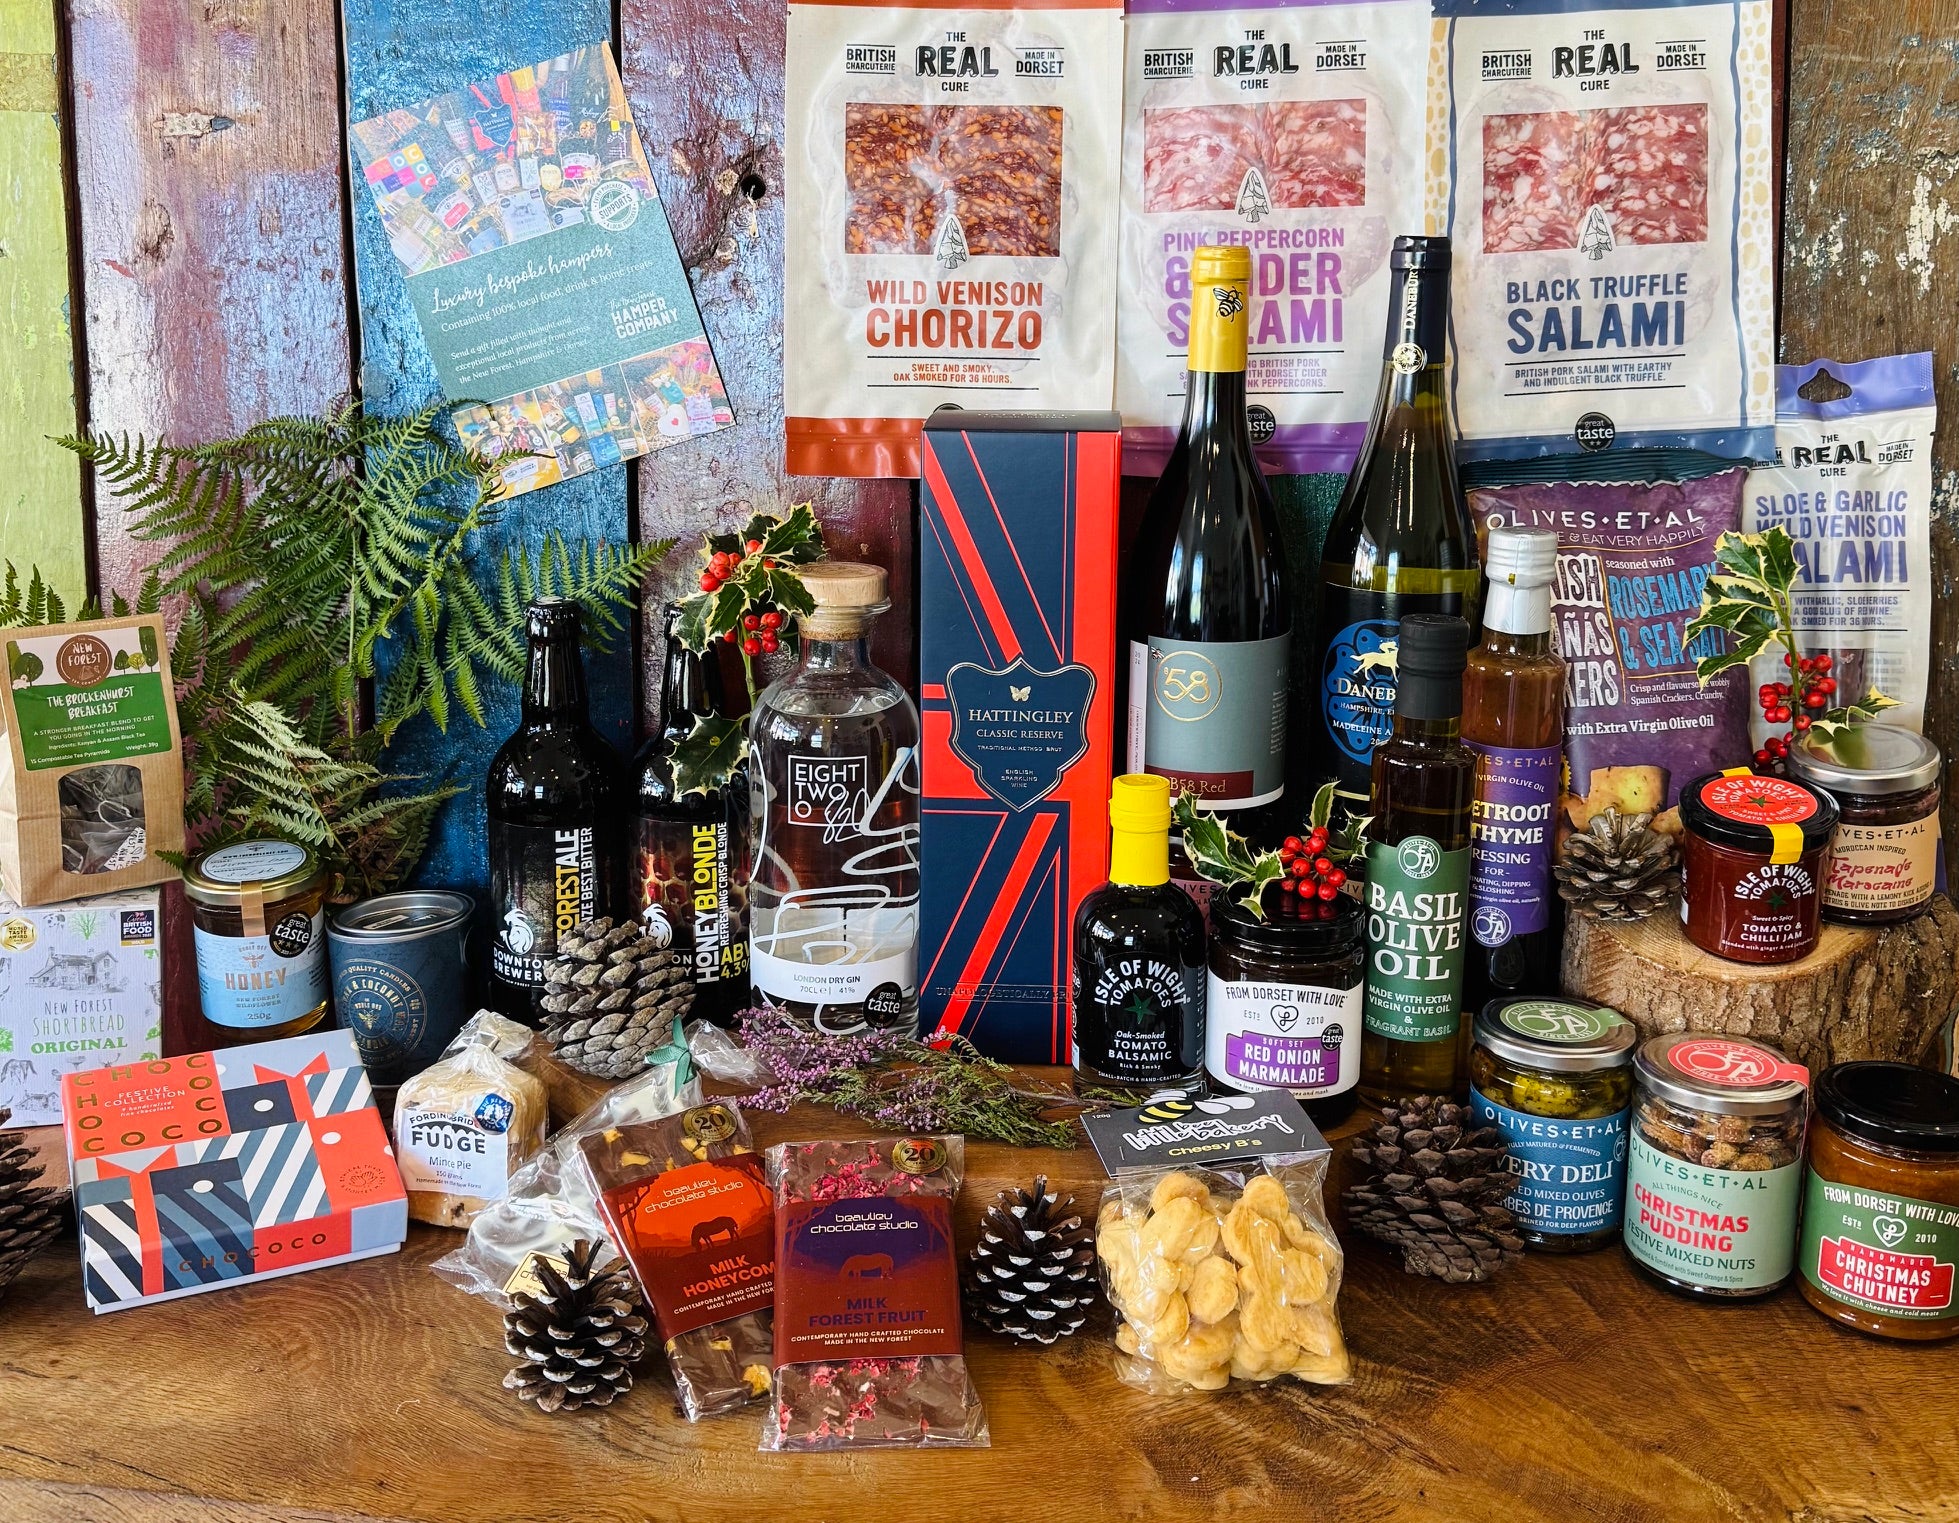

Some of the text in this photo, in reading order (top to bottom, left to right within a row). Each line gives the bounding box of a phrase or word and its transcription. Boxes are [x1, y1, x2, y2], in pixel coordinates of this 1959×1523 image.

[946, 32, 966, 42] THE
[847, 48, 896, 62] BRITISH
[916, 46, 998, 78] REAL
[1144, 53, 1193, 67] BRITISH
[1213, 43, 1299, 77] REAL
[1316, 53, 1366, 67] DORSET
[1482, 54, 1531, 69] BRITISH
[1552, 43, 1639, 79] REAL
[1657, 53, 1706, 68] DORSET
[846, 61, 895, 71] CHARCUTERIE
[1016, 61, 1064, 74] DORSET
[942, 82, 969, 92] CURE
[1240, 78, 1269, 90] CURE
[1581, 80, 1610, 91] CURE
[598, 191, 634, 219] SUPPORTS
[1165, 228, 1344, 252] PINK PEPPERCORN
[431, 243, 613, 314] Luxury bespoke hampers
[867, 280, 1042, 306] WILD VENISON
[1507, 273, 1687, 304] BLACK TRUFFLE
[442, 287, 564, 332] Containing 100% local food,
[612, 297, 668, 326] HAMPER
[616, 307, 679, 339] COMPANY
[866, 308, 1042, 349] CHORIZO
[1507, 301, 1684, 354] SALAMI
[912, 363, 994, 373] SWEET AND SMOKY.
[1515, 362, 1672, 379] BRITISH PORK SALAMI WITH EARTHY
[893, 373, 1012, 384] OAK SMOKED FOR 36 HOURS.
[1791, 441, 1872, 469] REAL
[1878, 449, 1912, 462] DORSET
[1820, 468, 1846, 477] CURE
[1756, 490, 1908, 517] SLOE & GARLIC
[1570, 523, 1705, 547] & EAT VERY HAPPILY
[1820, 514, 1906, 538] VENISON
[1606, 556, 1675, 569] seasoned with
[73, 642, 93, 653] NEW
[68, 652, 102, 667] FOREST
[47, 686, 134, 708] THE BROCKENHURST
[68, 702, 118, 720] BREAKFAST
[969, 709, 1073, 724] HATTINGLEY
[1332, 720, 1383, 735] MADELEINE
[1567, 714, 1714, 735] with Extra Virgin Olive Oil
[976, 729, 1064, 739] CLASSIC RESERVE
[795, 764, 860, 782] EIGHT
[1170, 777, 1226, 793] B58 Red
[1836, 845, 1906, 855] MOROCCAN INSPIRED
[581, 827, 594, 900] BEST BITTER
[717, 822, 729, 945] REFRESHING CRISP BLONDE
[1761, 864, 1815, 895] OF WIGHT
[1751, 878, 1801, 900] TOMATOES
[1370, 882, 1462, 922] BASIL
[275, 923, 310, 944] taste
[1368, 915, 1460, 952] OLIVE
[1740, 931, 1802, 942] CHILLI JAM
[1742, 924, 1792, 932] TOMATO
[1374, 950, 1450, 981] OIL
[225, 967, 287, 991] HONEY
[793, 974, 860, 984] LONDON DRY GIN
[1094, 959, 1189, 1005] ISLE OF WIGHT
[1110, 978, 1171, 1008] TOMATOES
[1226, 987, 1321, 1004] FROM DORSET WITH
[1369, 984, 1452, 1004] MADE WITH EXTRA
[44, 999, 113, 1015] NEW FOREST
[248, 1011, 271, 1021] 250g
[33, 1014, 125, 1037] SHORTBREAD
[31, 1036, 128, 1054] ORIGINAL
[1114, 1040, 1167, 1050] TOMATO
[1322, 1034, 1342, 1042] taste
[1108, 1050, 1172, 1062] BALSAMIC
[1245, 1045, 1321, 1064] RED ONION
[1239, 1060, 1325, 1082] MARMALADE
[104, 1090, 186, 1108] COLLECTION
[119, 1086, 170, 1100] FESTIVE
[412, 1131, 486, 1154] FUDGE
[1169, 1138, 1262, 1156] Cheesy B's
[1562, 1161, 1613, 1185] DELI
[1534, 1189, 1605, 1200] MIXED OLIVES
[1824, 1186, 1936, 1221] FROM DORSET WITH
[1534, 1199, 1613, 1219] DE PROVENCE
[1634, 1183, 1749, 1233] CHRISTMAS
[835, 1213, 893, 1222] beaulieu
[810, 1220, 919, 1234] chocolate studio
[1639, 1208, 1733, 1252] PUDDING
[1915, 1234, 1937, 1243] 2010
[179, 1233, 326, 1273] CHOCOCO
[1666, 1244, 1714, 1268] MIXED
[1717, 1257, 1755, 1271] NUTS
[709, 1254, 750, 1274] MILK
[1836, 1250, 1931, 1286] CHRISTMAS
[1843, 1272, 1919, 1304] CHUTNEY
[846, 1298, 887, 1311] MILK
[809, 1310, 926, 1328] FOREST FRUIT
[791, 1328, 945, 1343] CONTEMPORARY HAND CRAFTED CHOCOLATE
